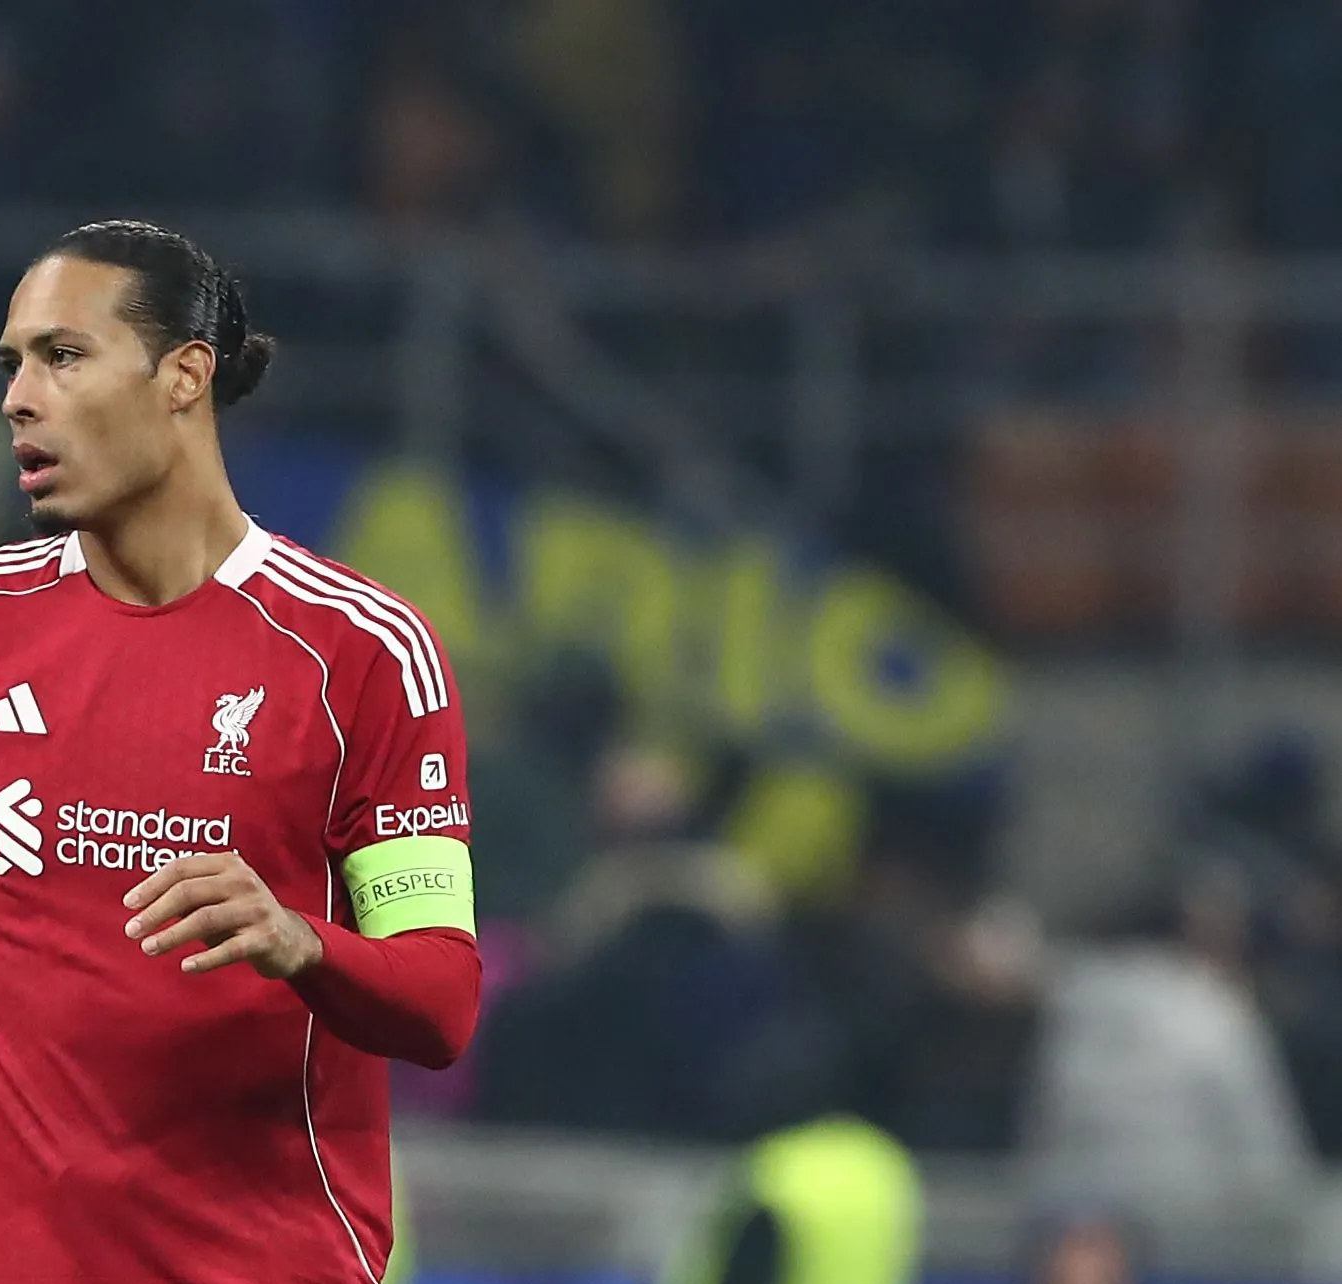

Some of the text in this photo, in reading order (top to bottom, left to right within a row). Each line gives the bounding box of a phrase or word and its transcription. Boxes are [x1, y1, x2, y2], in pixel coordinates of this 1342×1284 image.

[56, 800, 231, 847] standard
[56, 833, 239, 873] charte
[371, 872, 455, 902] RESPECT
